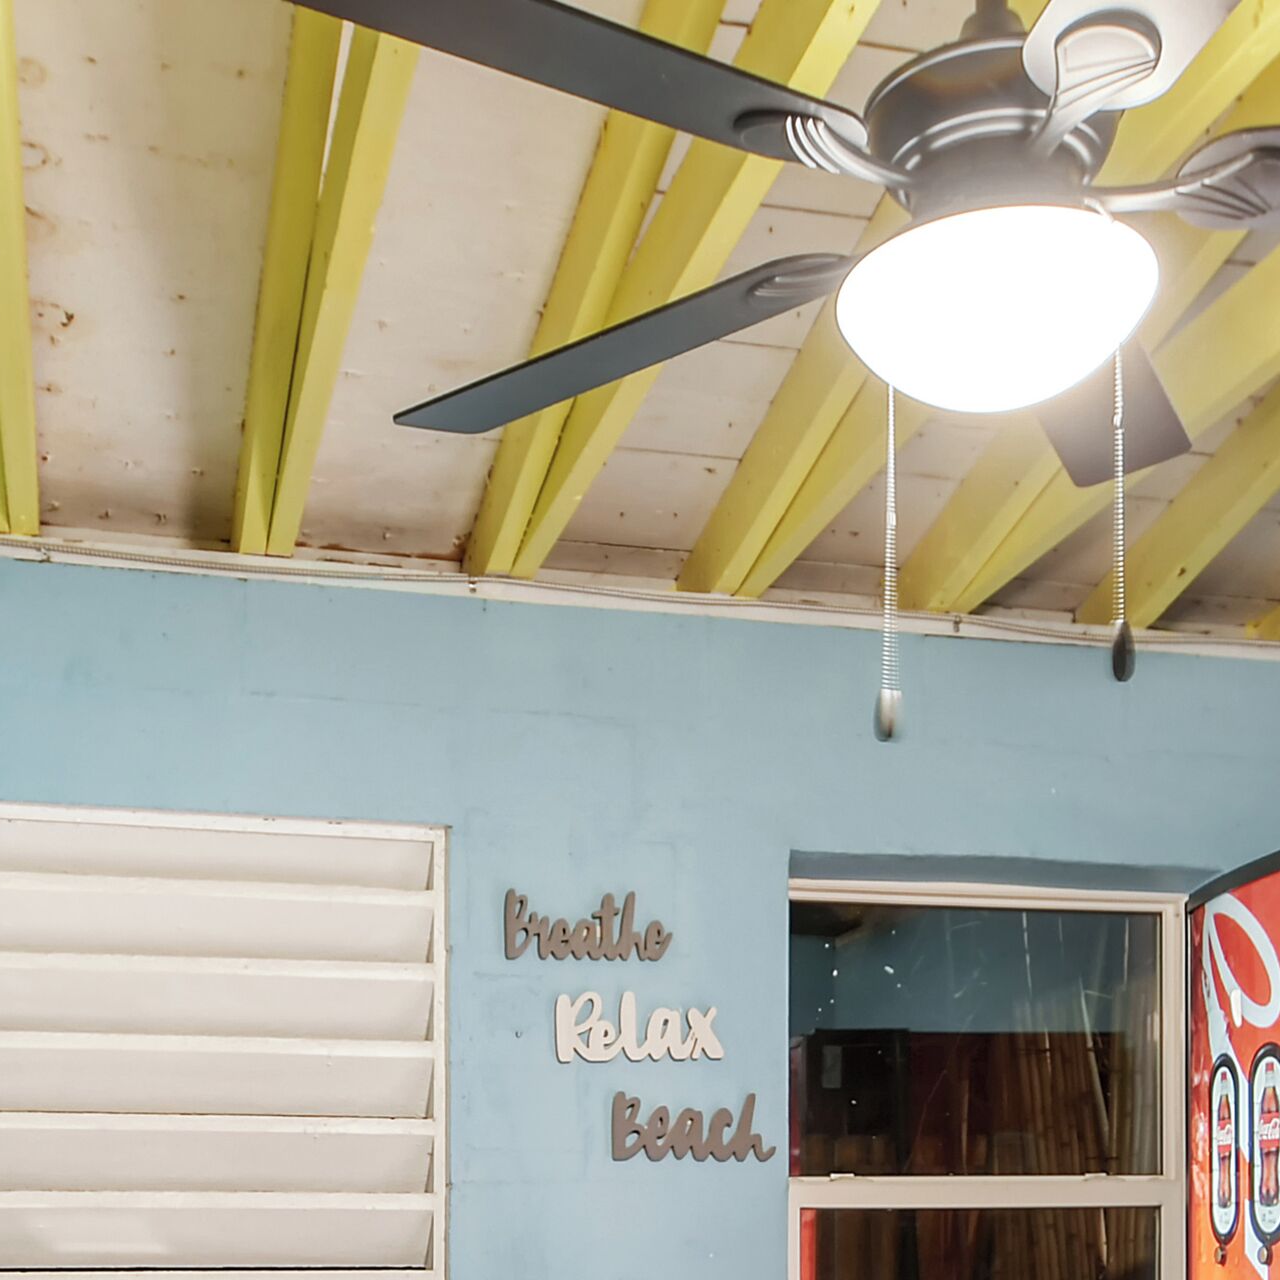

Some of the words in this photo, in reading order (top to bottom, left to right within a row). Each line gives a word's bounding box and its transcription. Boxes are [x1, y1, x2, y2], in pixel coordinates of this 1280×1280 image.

[505, 888, 673, 961] Breathe
[556, 991, 724, 1063] Relax
[611, 1091, 777, 1162] Beach
